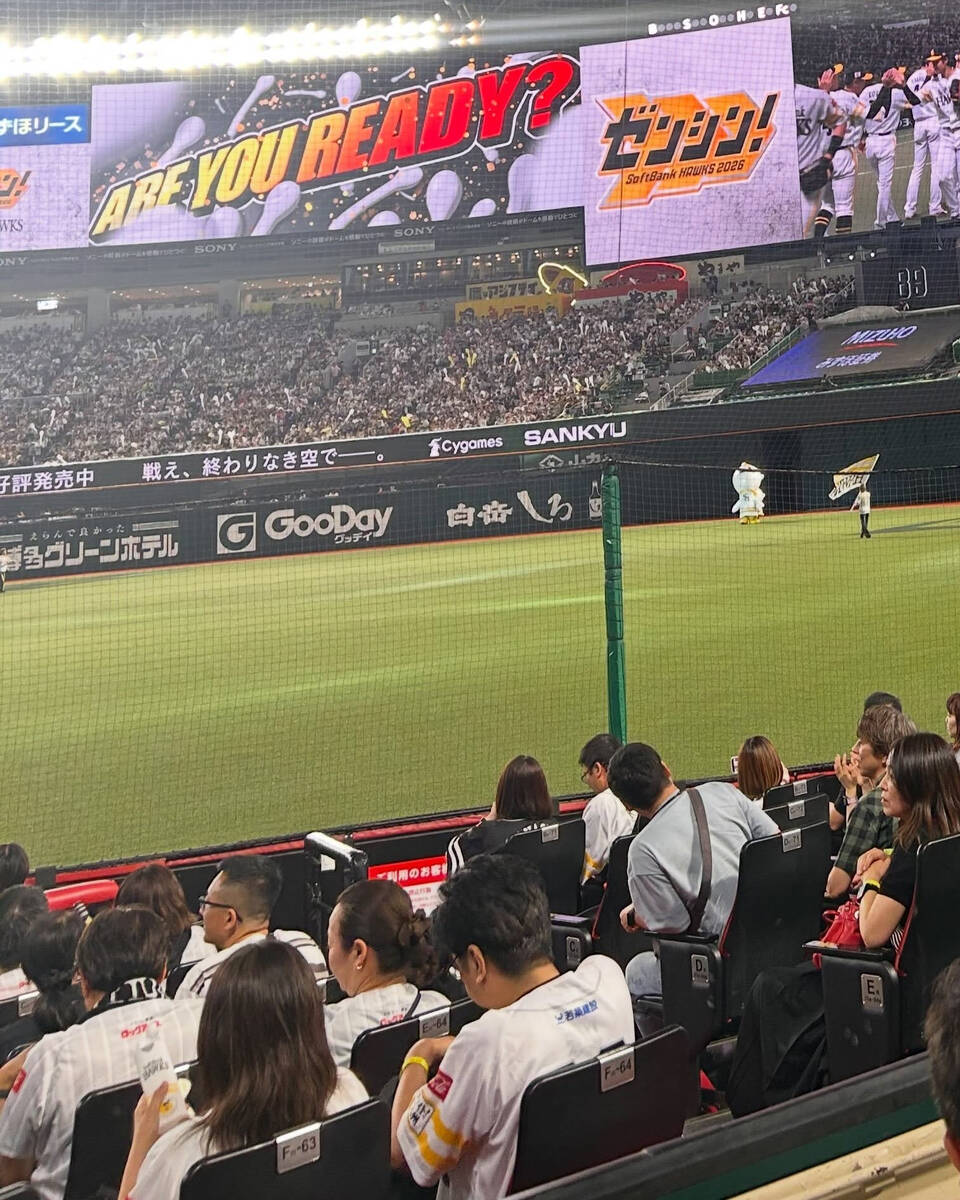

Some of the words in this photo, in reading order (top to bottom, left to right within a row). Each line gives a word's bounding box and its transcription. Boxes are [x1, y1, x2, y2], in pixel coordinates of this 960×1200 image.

[600, 94, 779, 172] ゼンシン!
[92, 160, 190, 236] ARE
[190, 125, 298, 210] YOU
[296, 58, 576, 185] READY?
[626, 170, 676, 185] SoftBank
[679, 164, 715, 178] HAWKS
[717, 159, 746, 173] 2026
[394, 226, 436, 238] SONY
[194, 243, 238, 254] SONY
[841, 325, 918, 346] MIZUHO
[524, 421, 627, 446] SANKYU
[441, 436, 503, 455] Cygames
[30, 524, 126, 541] えらんで良かった
[264, 504, 394, 541] GooDay
